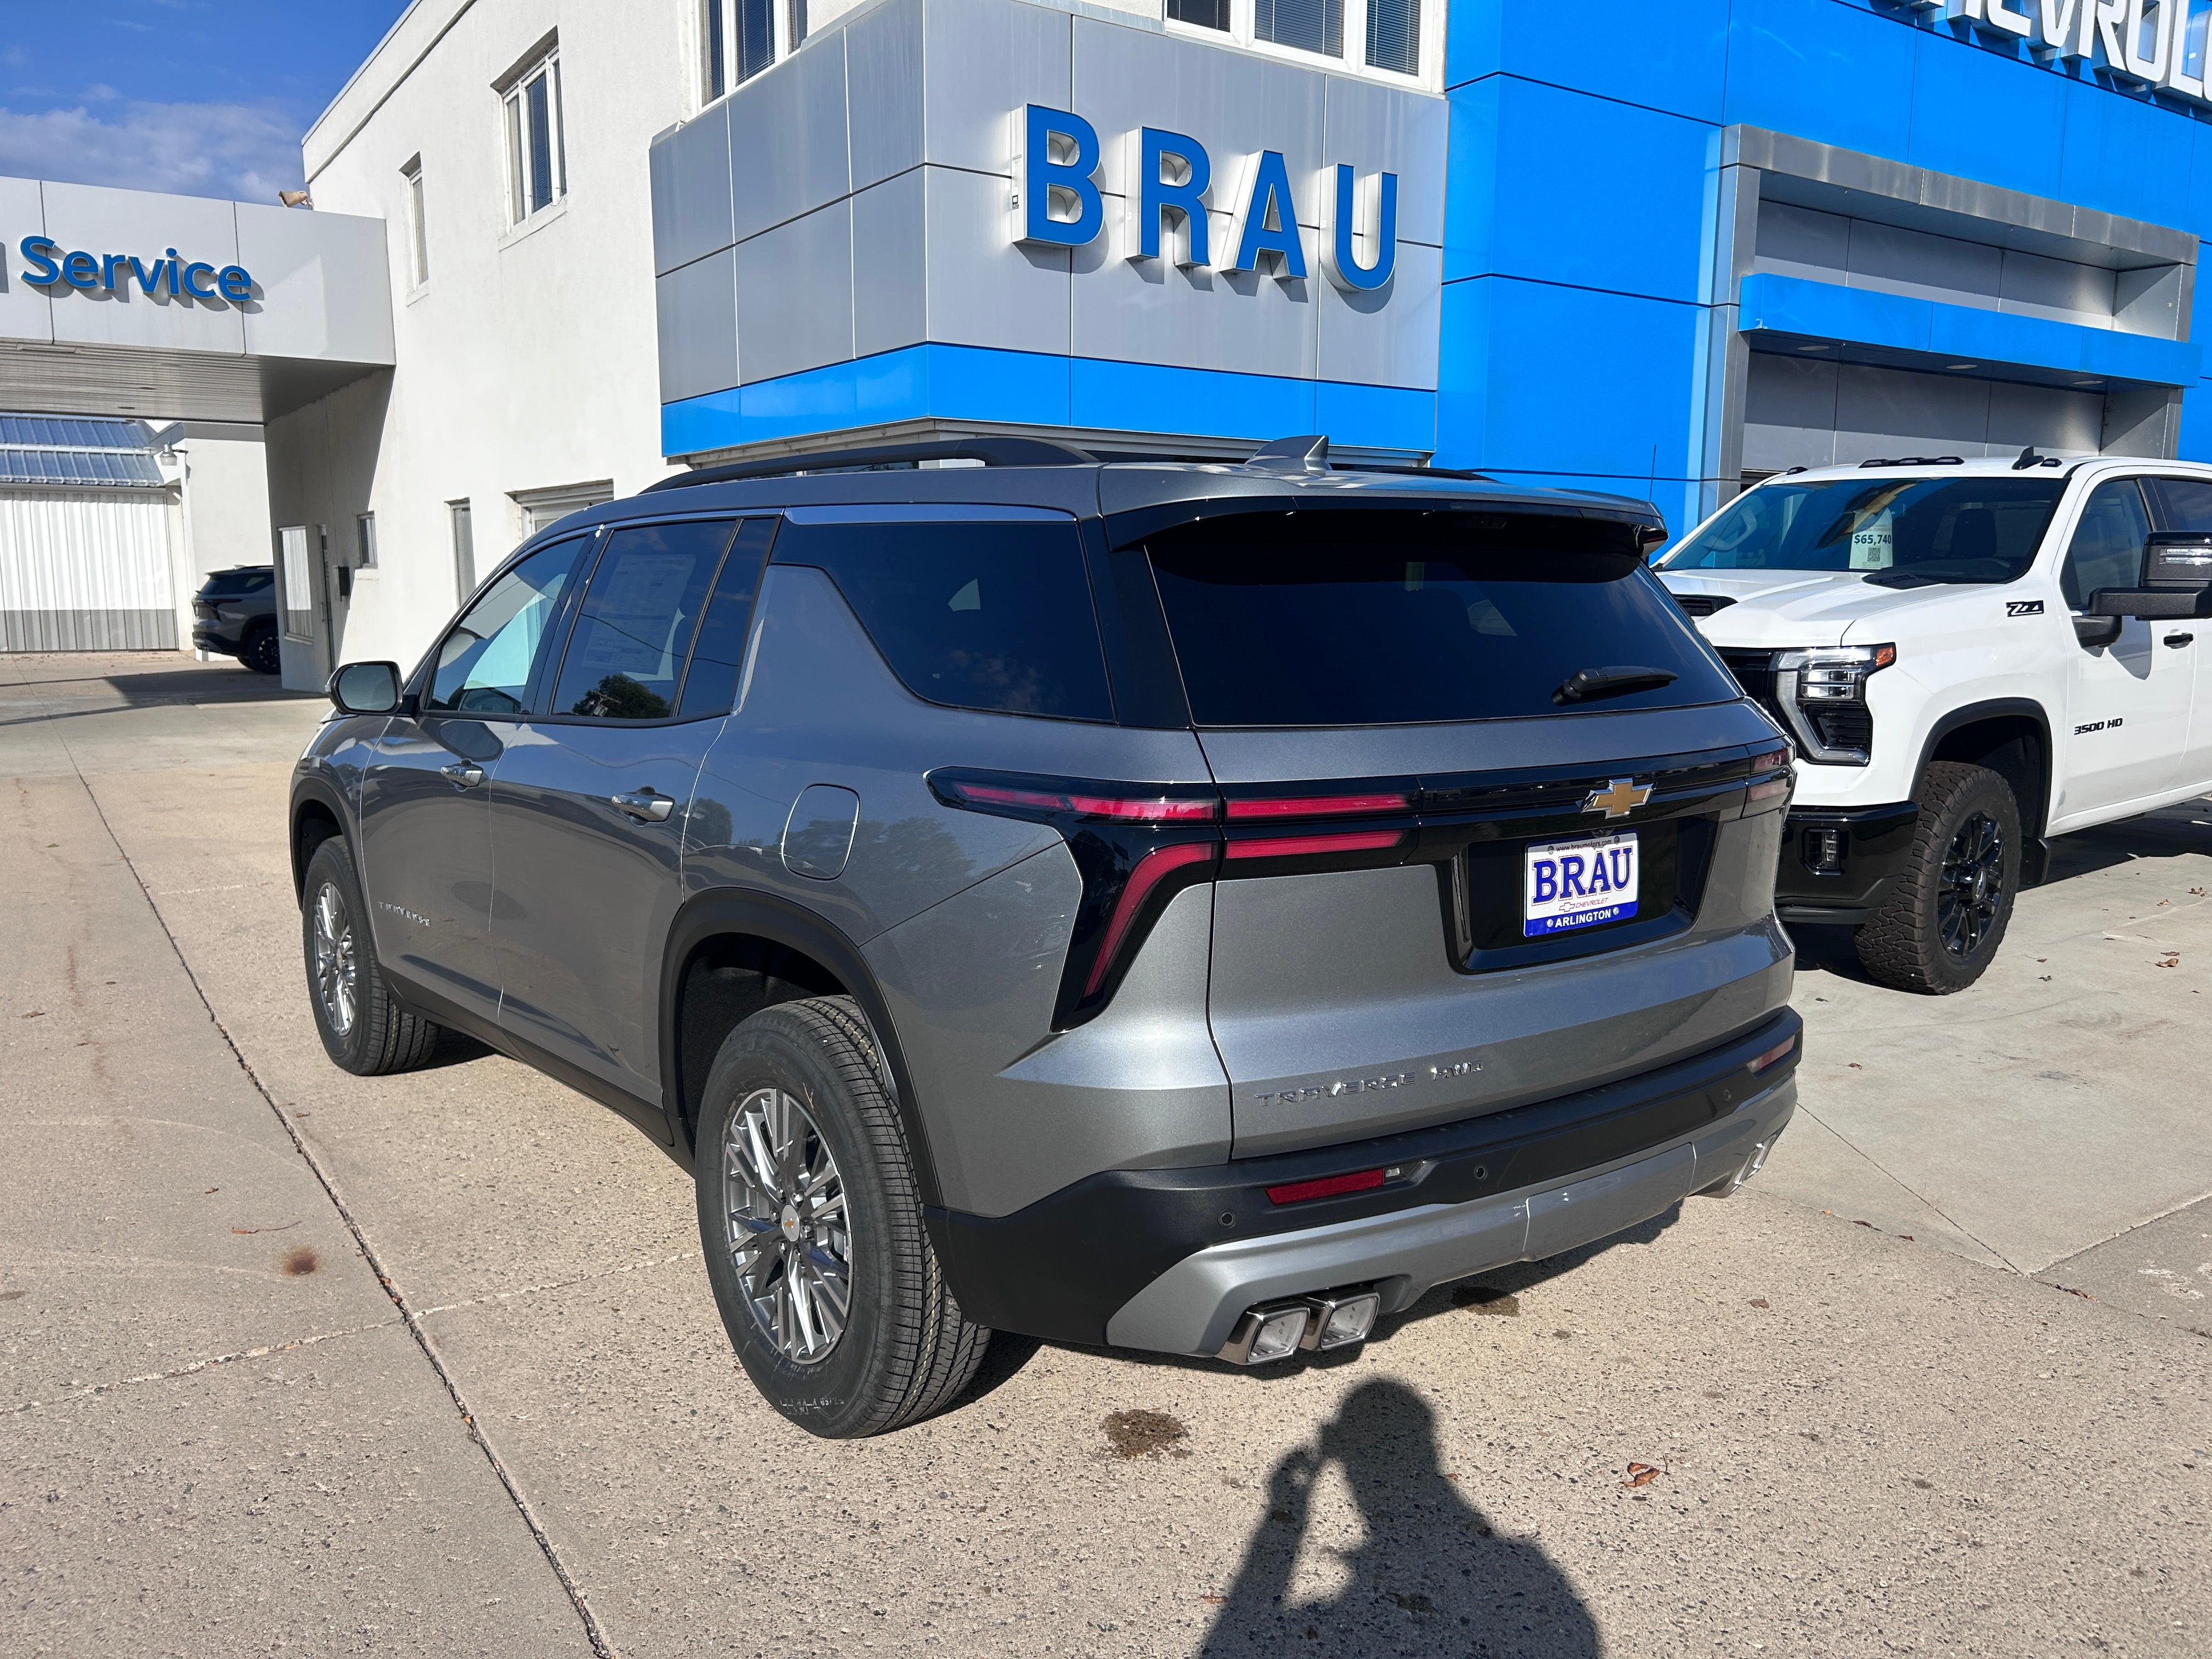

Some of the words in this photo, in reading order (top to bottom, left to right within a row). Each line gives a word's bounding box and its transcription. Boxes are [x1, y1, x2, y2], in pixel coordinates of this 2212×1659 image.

[1026, 103, 1398, 291] BRAU
[19, 235, 253, 302] Service
[1854, 534, 1892, 546] $65,740
[2074, 721, 2104, 736] 3500
[2107, 718, 2123, 729] HD
[1555, 839, 1612, 852] www.braumotors.com
[1531, 845, 1633, 906] BRAU
[1575, 898, 1609, 909] CHEVROLET
[1554, 909, 1612, 928] ARLINGTON
[1254, 1071, 1417, 1107] TRAVERSE
